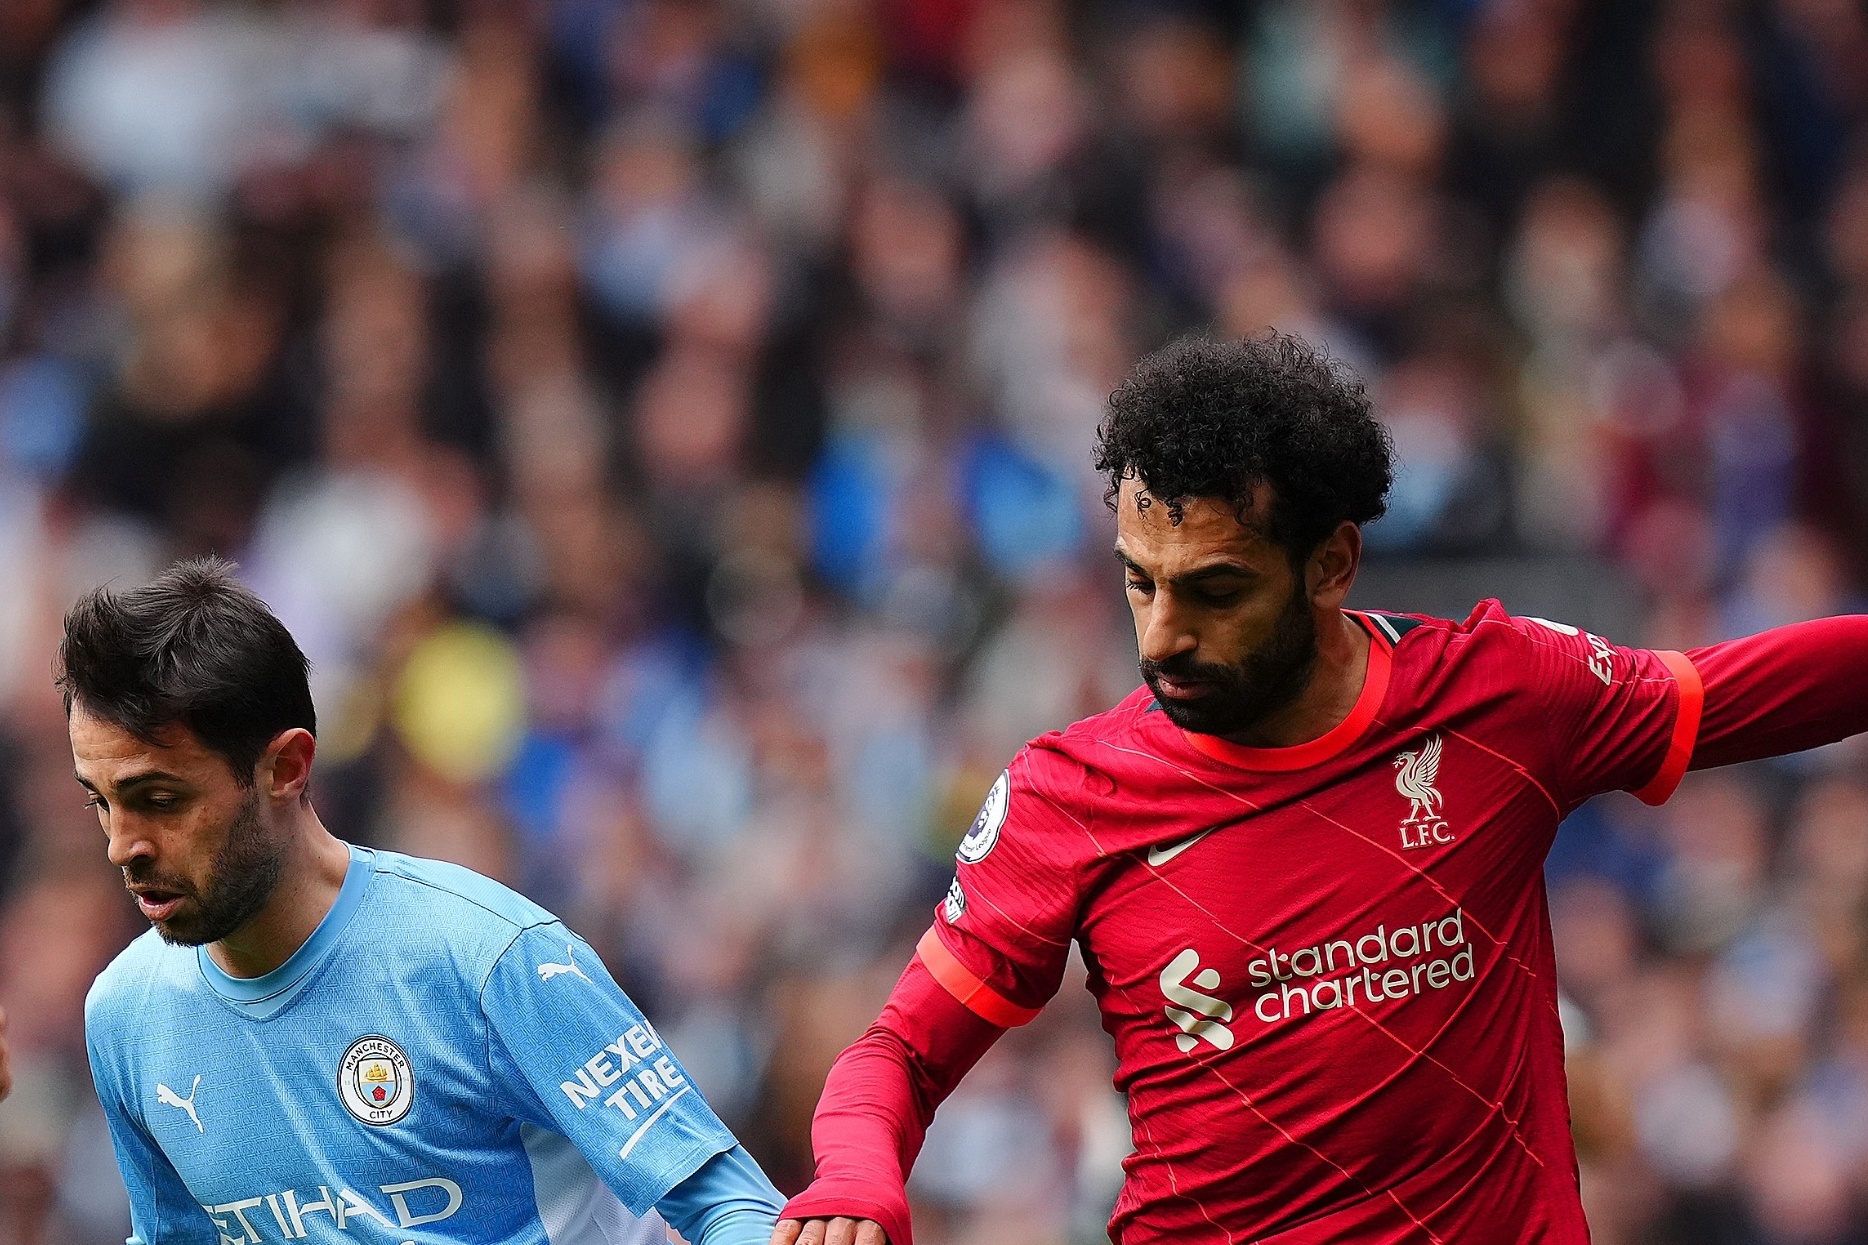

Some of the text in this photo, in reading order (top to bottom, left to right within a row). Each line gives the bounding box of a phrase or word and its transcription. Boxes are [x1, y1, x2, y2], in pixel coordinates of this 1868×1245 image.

[1400, 822, 1455, 848] L.F.C.
[1248, 907, 1464, 987] standard
[1254, 942, 1475, 1022] chartered
[345, 1042, 405, 1071] MANCHESTER
[604, 1055, 686, 1121] TIRE
[369, 1109, 393, 1119] CITY
